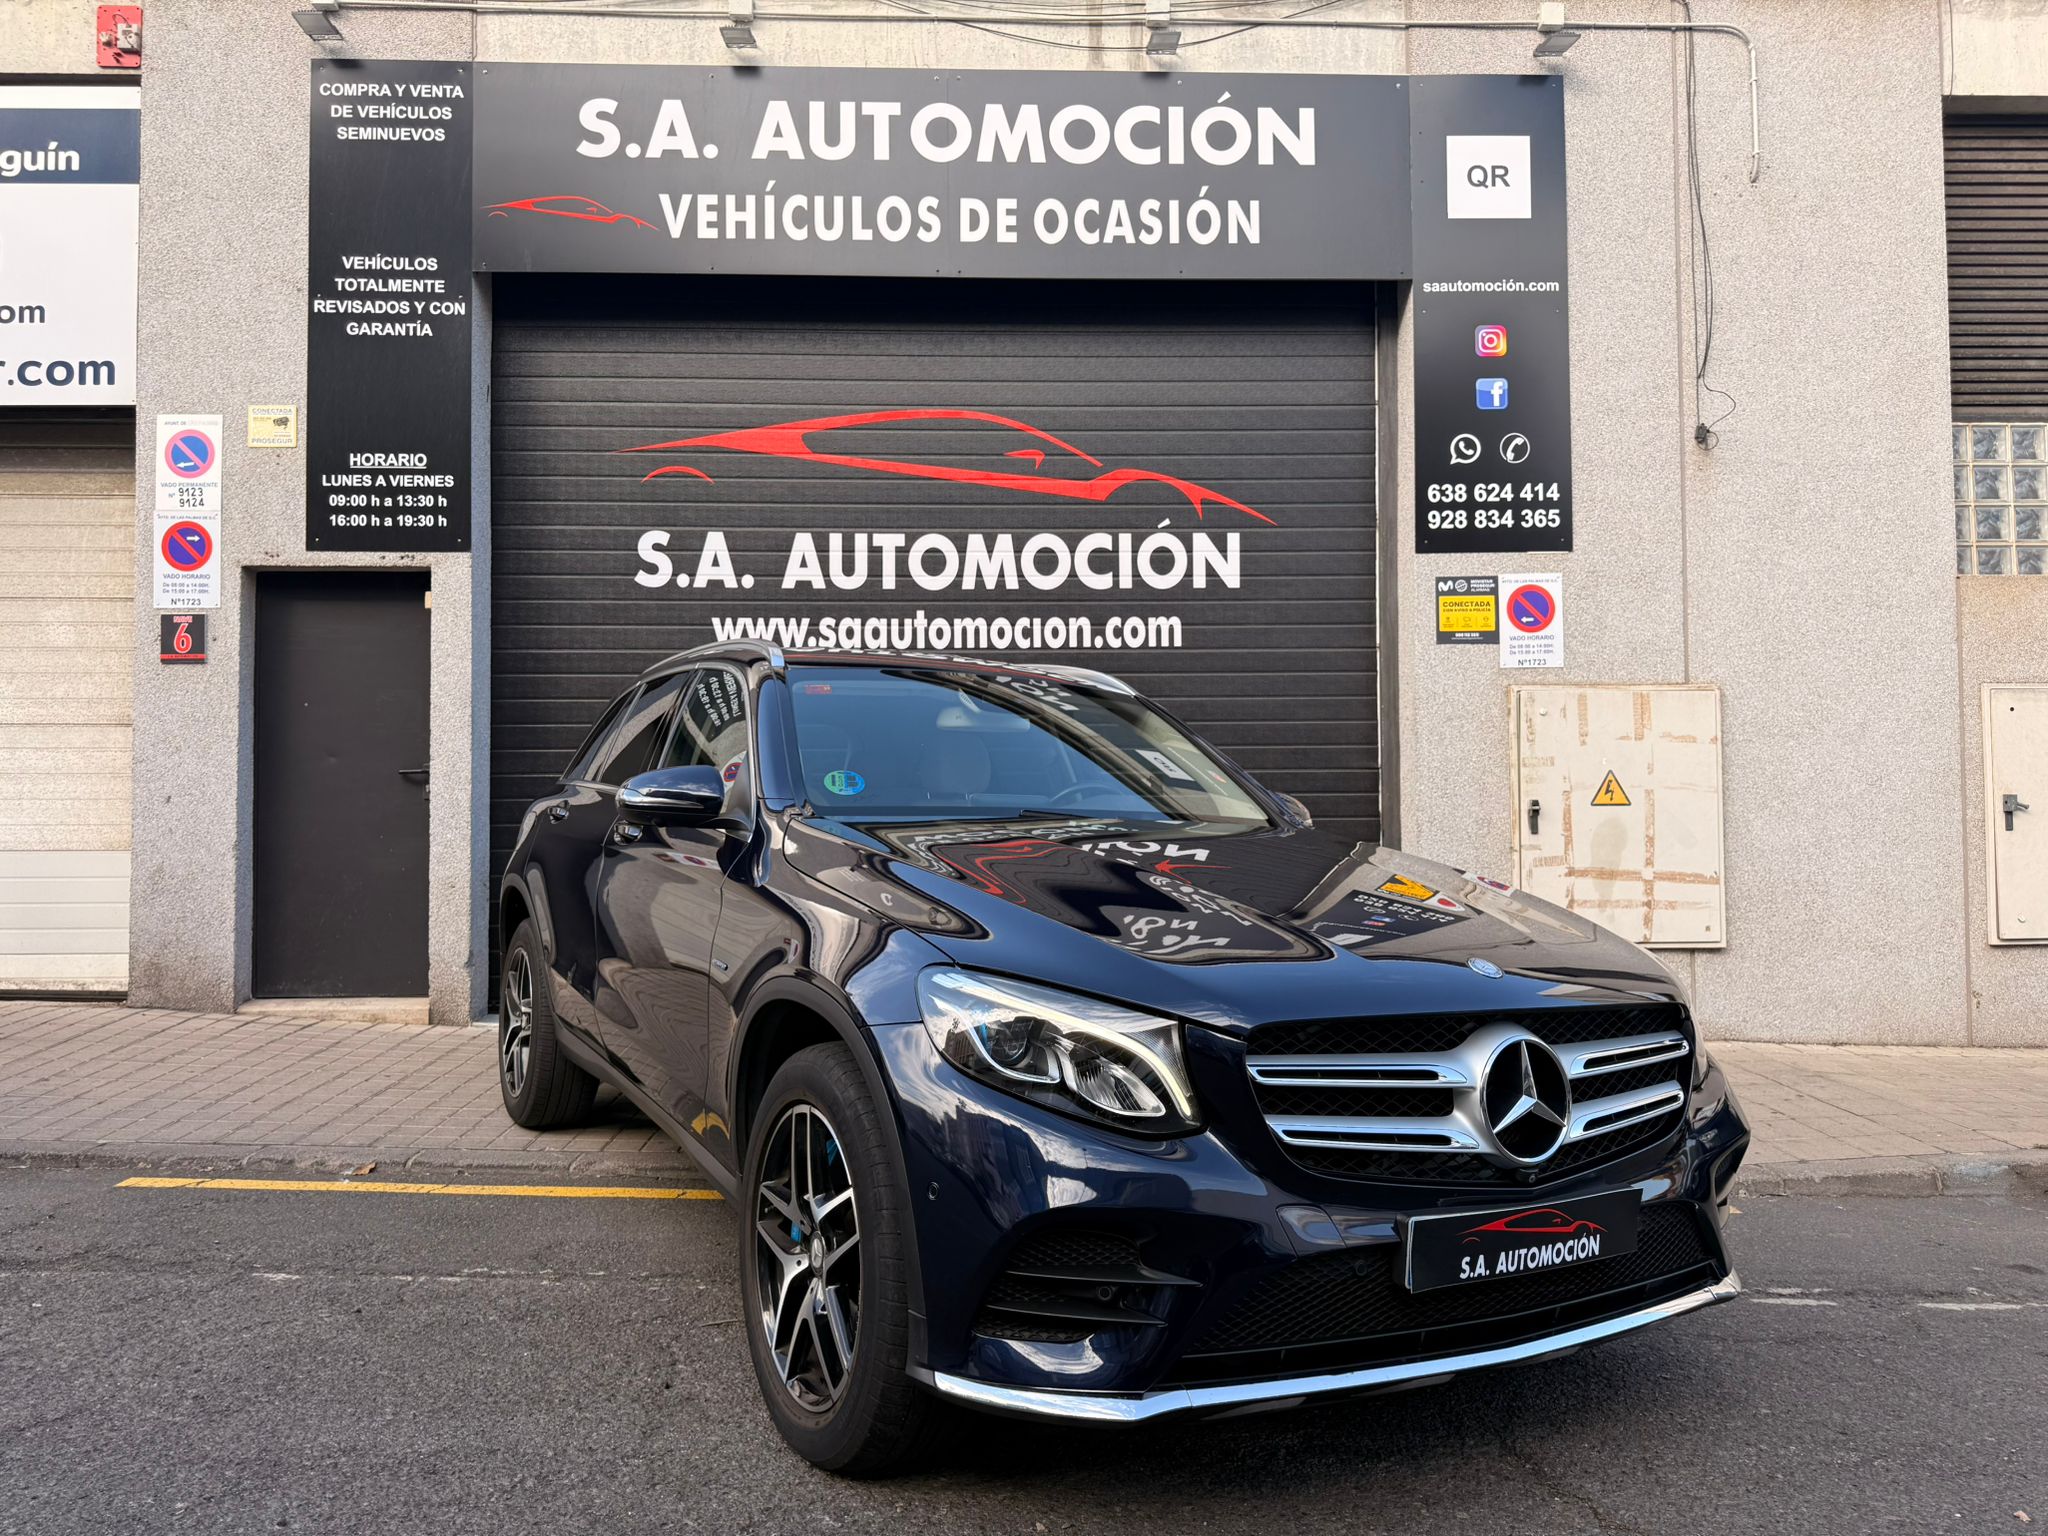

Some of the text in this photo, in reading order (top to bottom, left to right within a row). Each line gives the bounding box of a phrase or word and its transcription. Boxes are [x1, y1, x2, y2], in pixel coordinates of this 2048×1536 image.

[319, 83, 464, 98] COMPRA Y VENTA
[331, 102, 452, 120] DE VEHÍCULOS
[337, 127, 446, 142] SEMINUEVOS
[576, 91, 1315, 166] S.A. AUTOMOCIÓN
[1467, 165, 1510, 188] QR
[658, 180, 1260, 245] VEHÍCULOS DE OCASIÓN
[342, 253, 438, 271] VEHÍCULOS
[334, 277, 446, 293] TOTALMENTE
[1423, 279, 1560, 293] saautomoción.com
[314, 299, 466, 316] REVISADOS Y CON
[346, 320, 433, 337] GARANTÍA
[350, 453, 427, 468] HORARIO
[322, 474, 455, 488] LUNES A VIERNES
[178, 487, 203, 497] 9123
[328, 494, 448, 507] 09:00 h a 13:30 h
[1427, 482, 1560, 503] 638 624 414
[179, 498, 205, 508] 9124
[329, 514, 448, 527] 16:00 h a 19:30 h
[1427, 508, 1560, 529] 928 834 365
[634, 518, 1241, 590] S.A. AUTOMOCIÓN
[174, 623, 192, 653] 6
[1460, 1233, 1600, 1279] S.A. AUTOMOCIÓN
